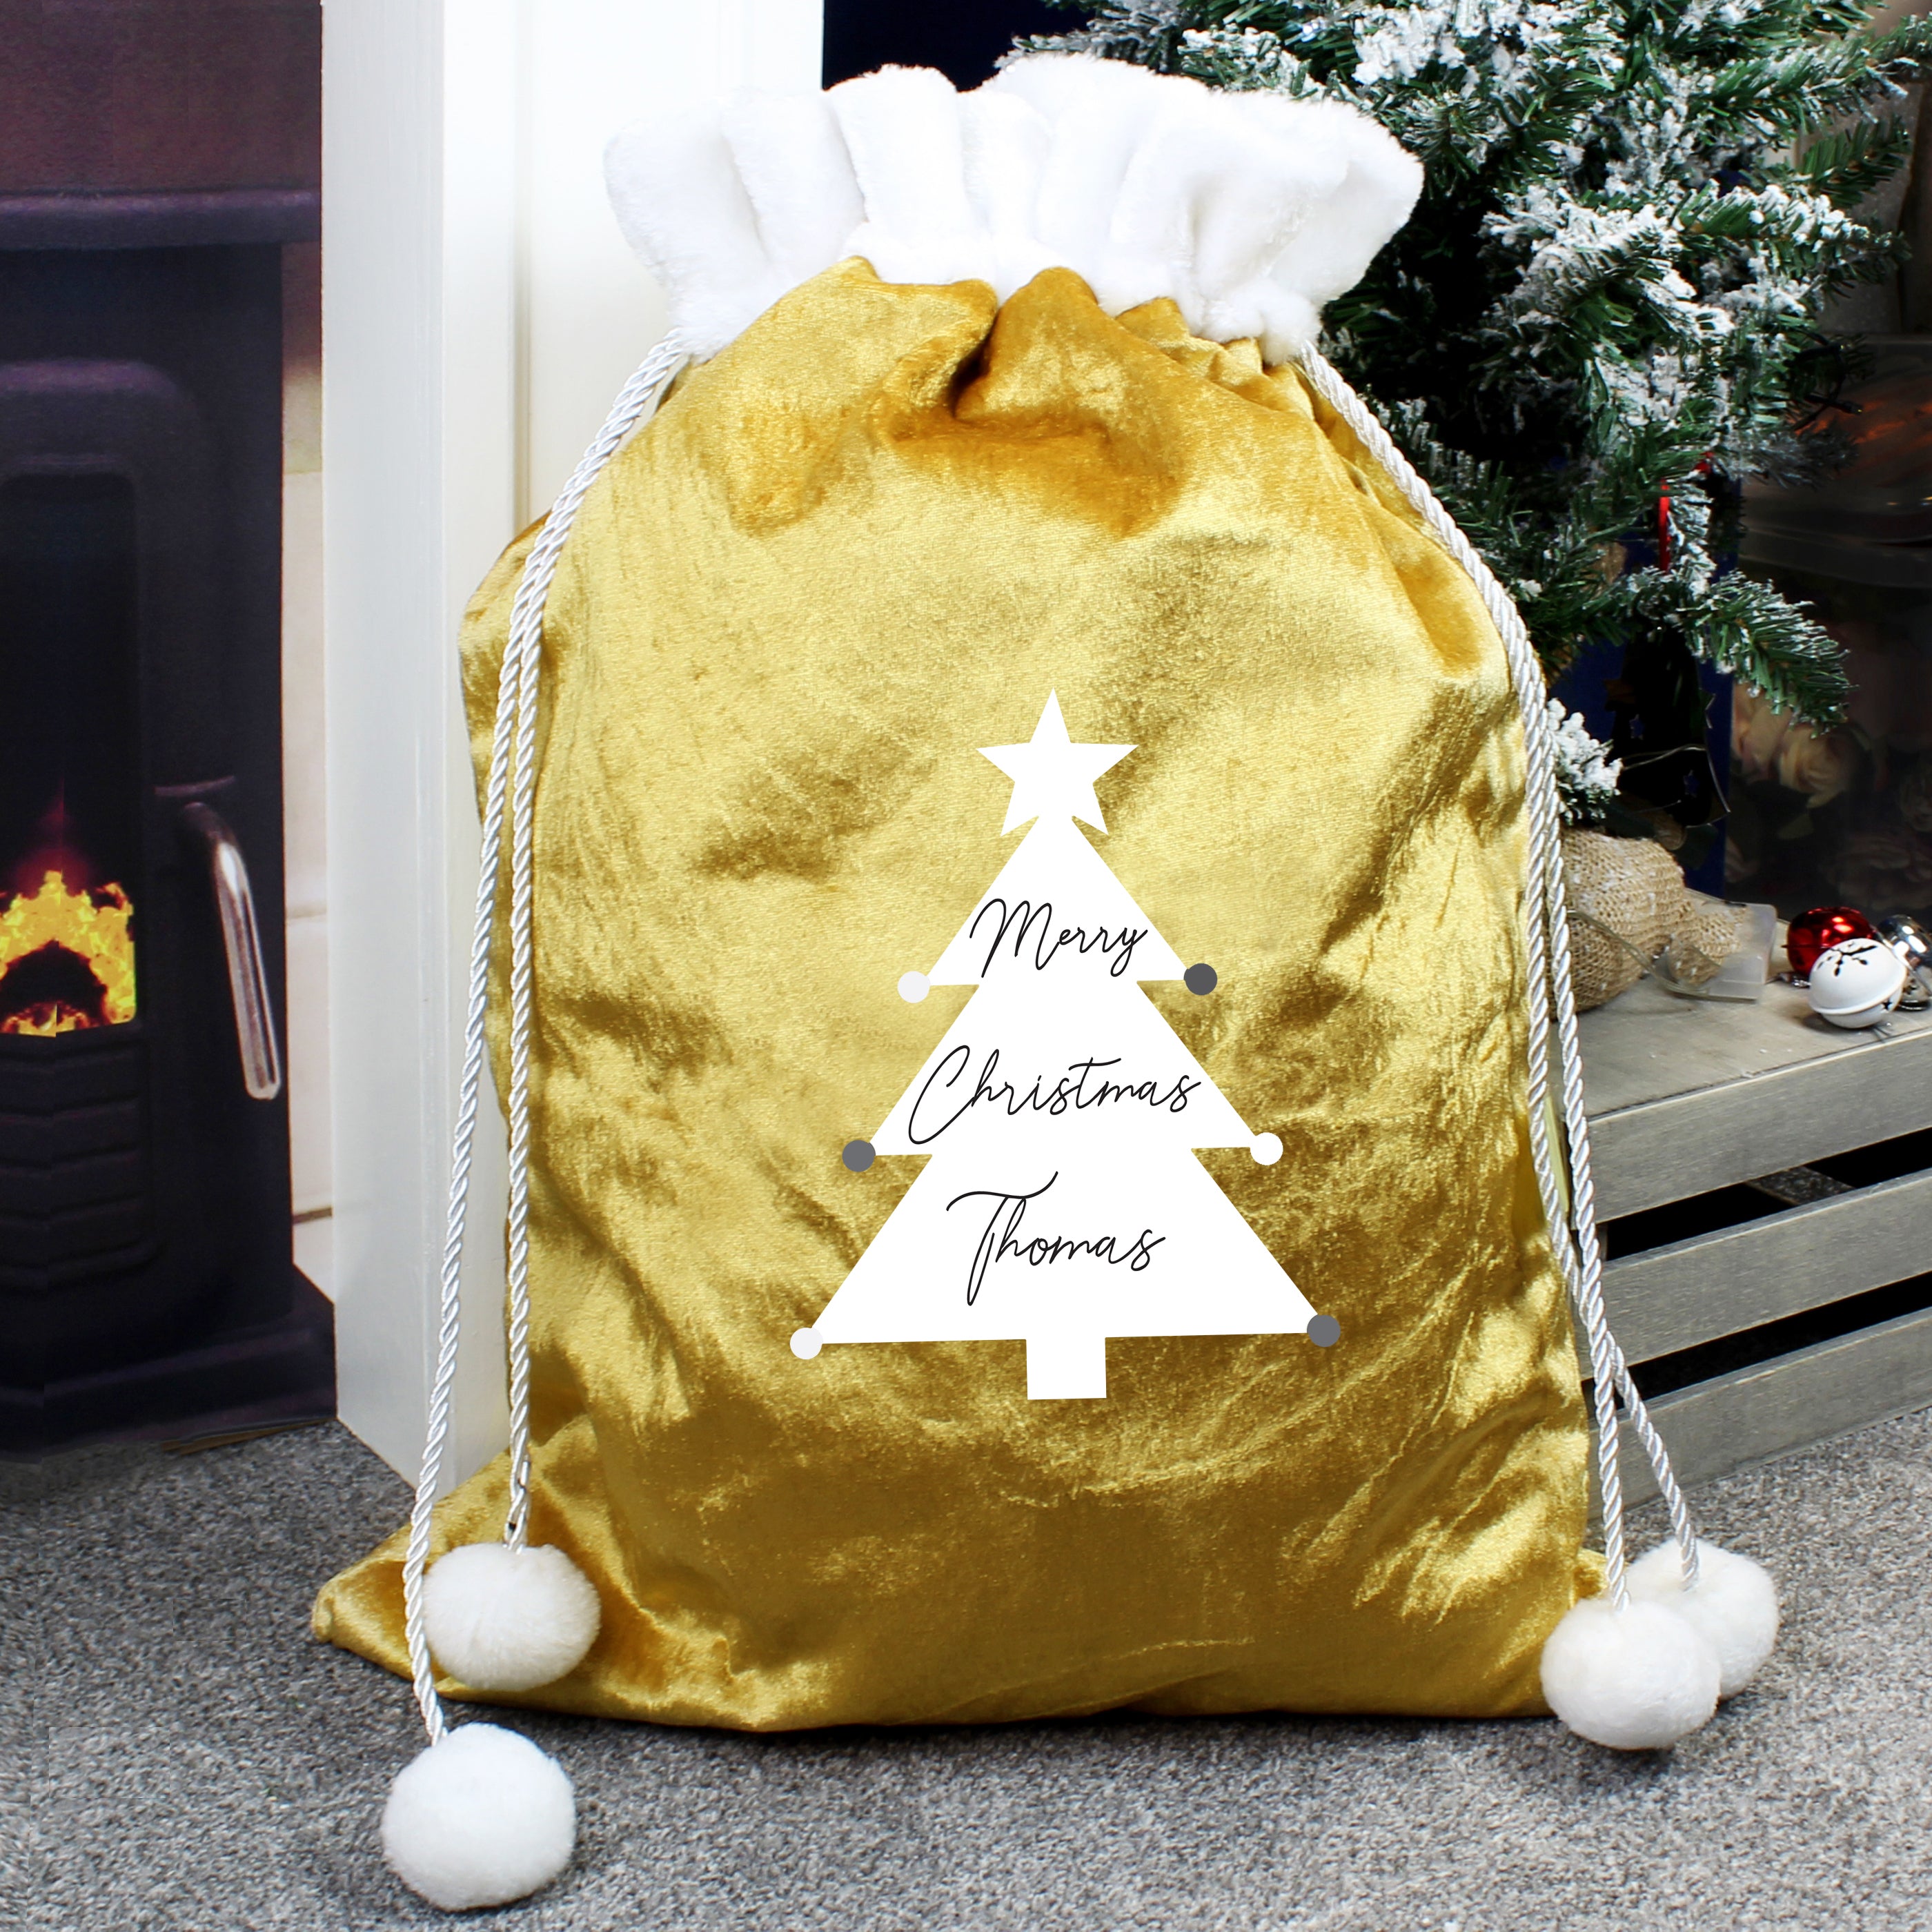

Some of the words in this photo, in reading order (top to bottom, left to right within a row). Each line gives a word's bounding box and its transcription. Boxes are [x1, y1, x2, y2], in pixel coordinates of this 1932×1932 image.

[969, 898, 1148, 978] Merry
[907, 1044, 1202, 1145] Christmas
[945, 1170, 1166, 1306] Thomas
